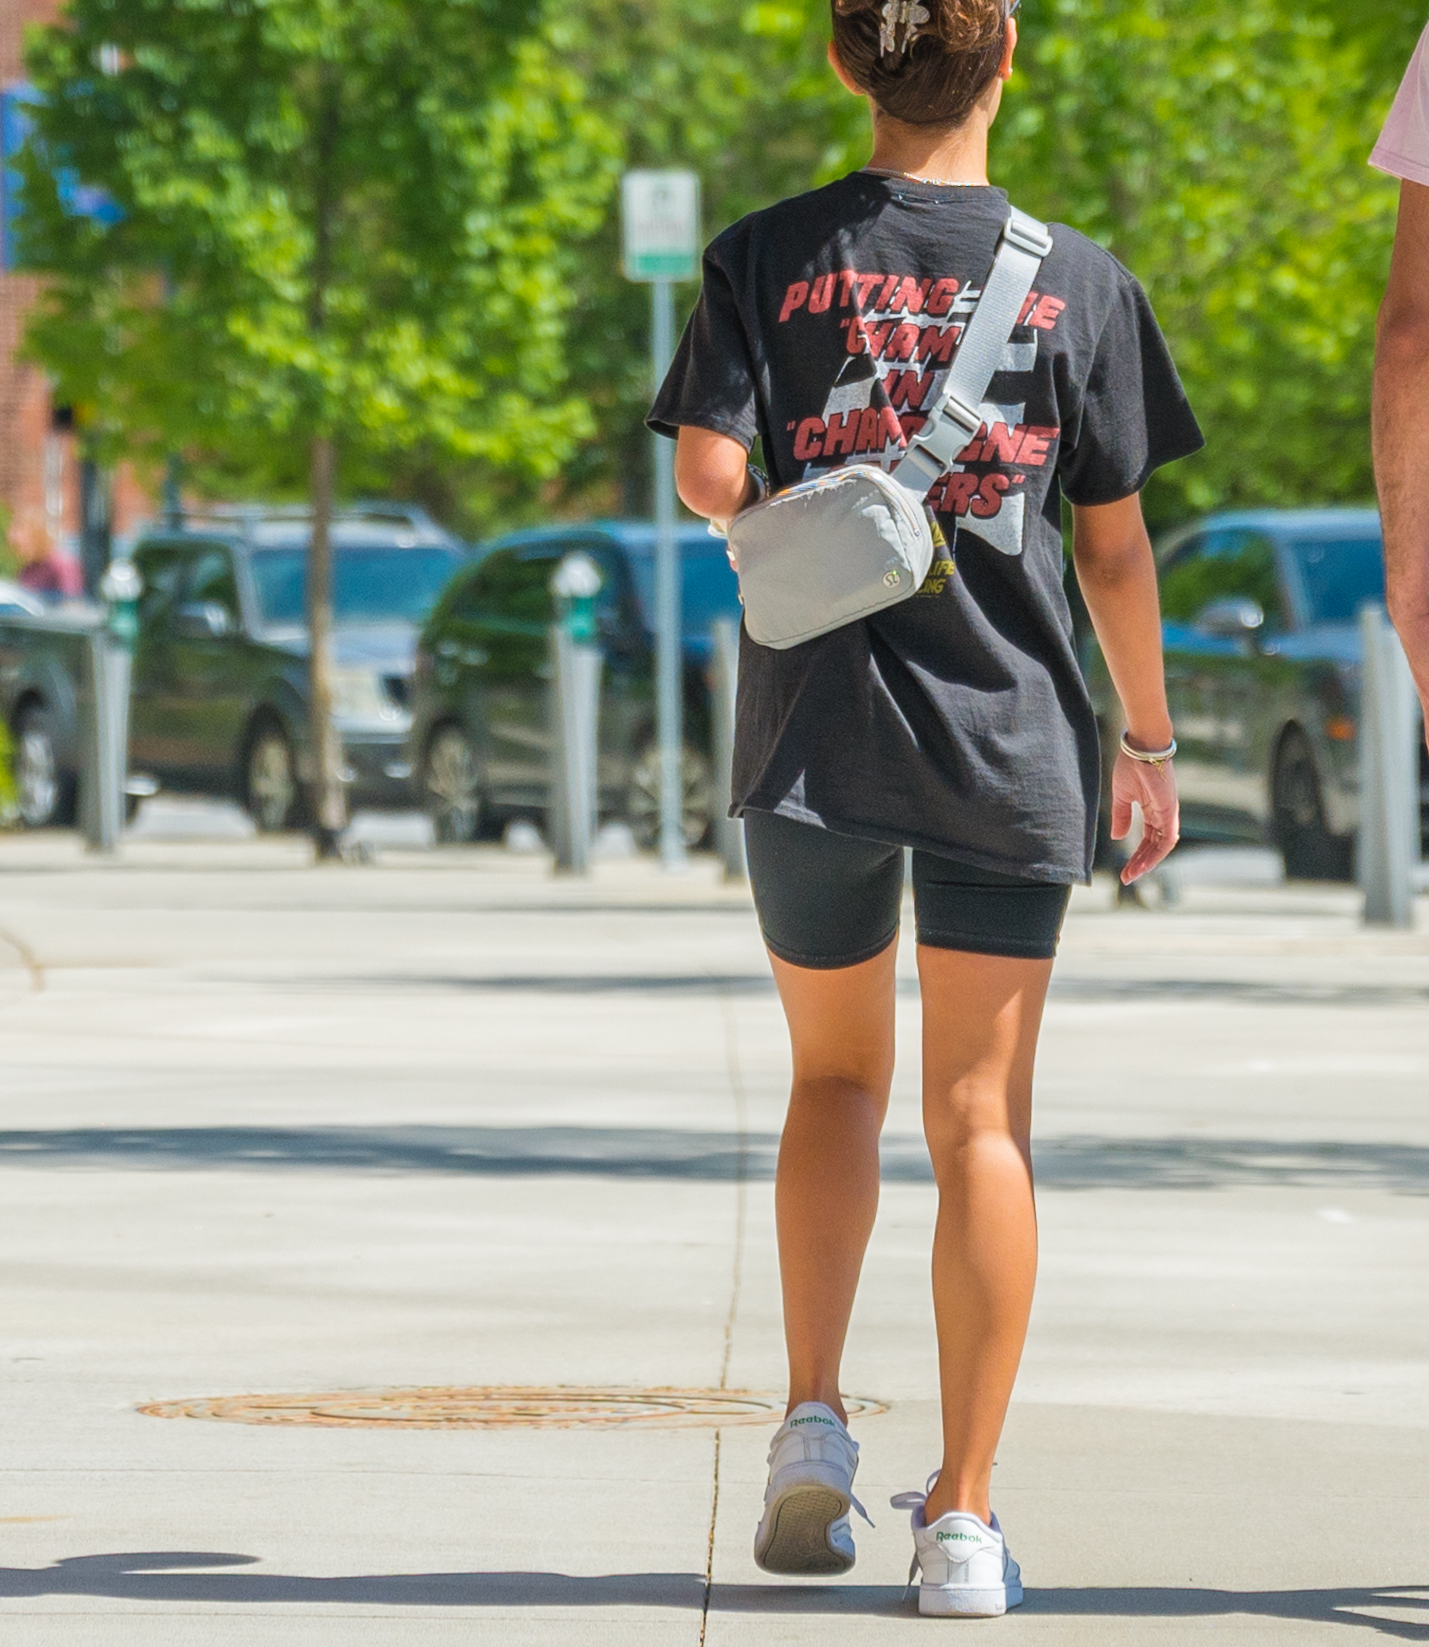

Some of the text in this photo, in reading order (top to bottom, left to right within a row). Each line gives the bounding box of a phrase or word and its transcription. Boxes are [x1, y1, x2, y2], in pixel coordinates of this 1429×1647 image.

[777, 269, 960, 323] PUTTING
[882, 369, 935, 407] IN
[790, 1415, 836, 1428] Reebok
[936, 1531, 983, 1544] Reebok
